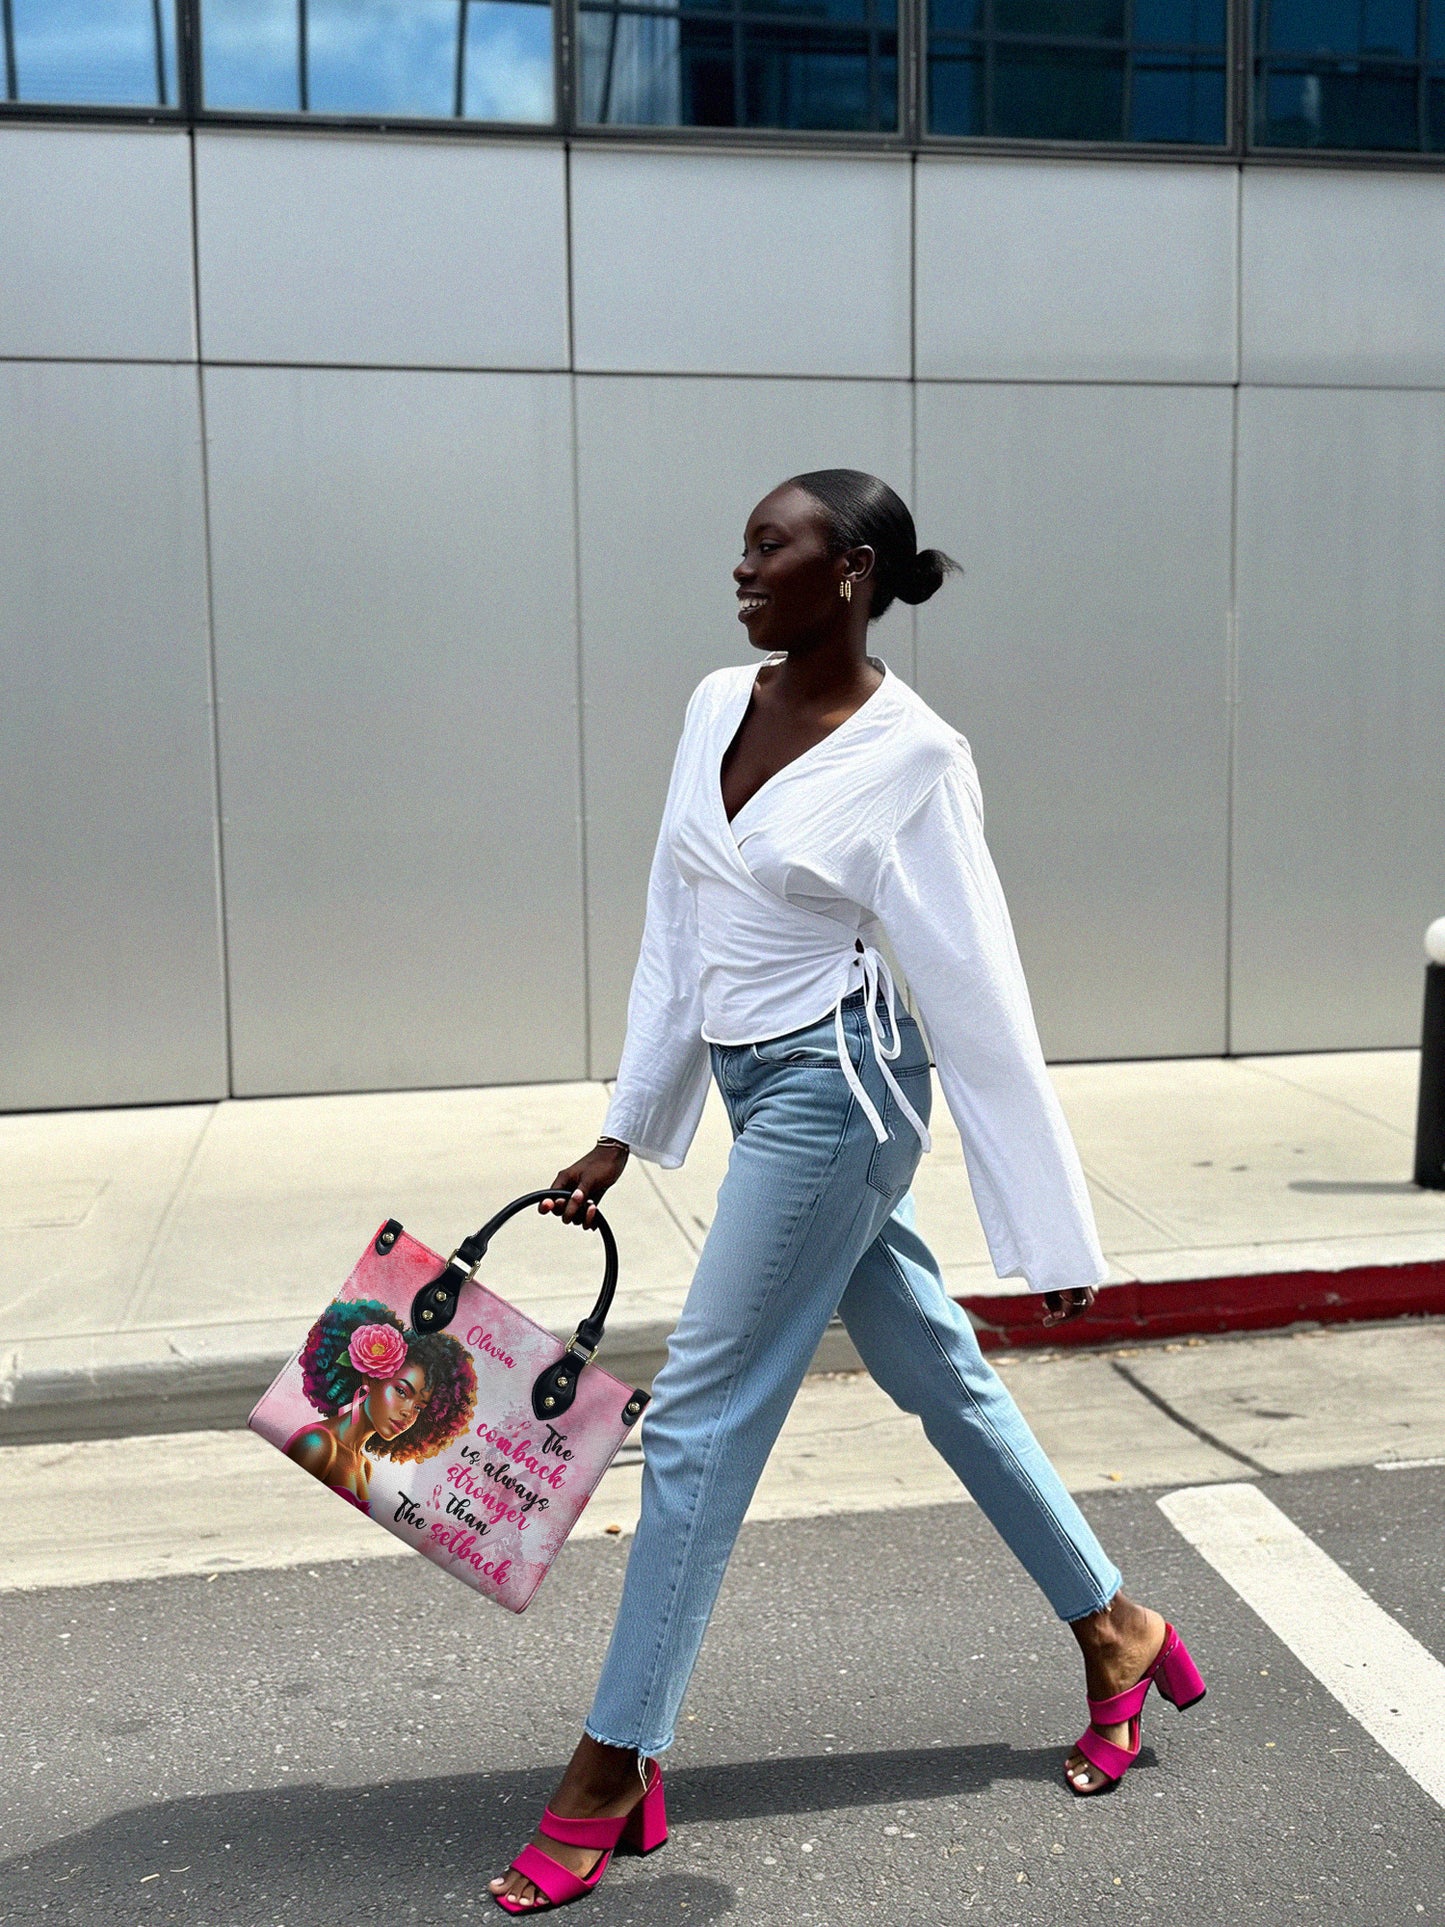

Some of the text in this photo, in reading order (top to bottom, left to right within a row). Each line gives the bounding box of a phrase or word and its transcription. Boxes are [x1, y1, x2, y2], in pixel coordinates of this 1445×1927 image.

[466, 1325, 518, 1369] Olivia
[476, 1423, 567, 1490] comback
[541, 1423, 575, 1461] The
[447, 1463, 531, 1531] stronger
[460, 1445, 550, 1513] is always
[393, 1491, 512, 1585] The setback
[445, 1491, 491, 1536] than
